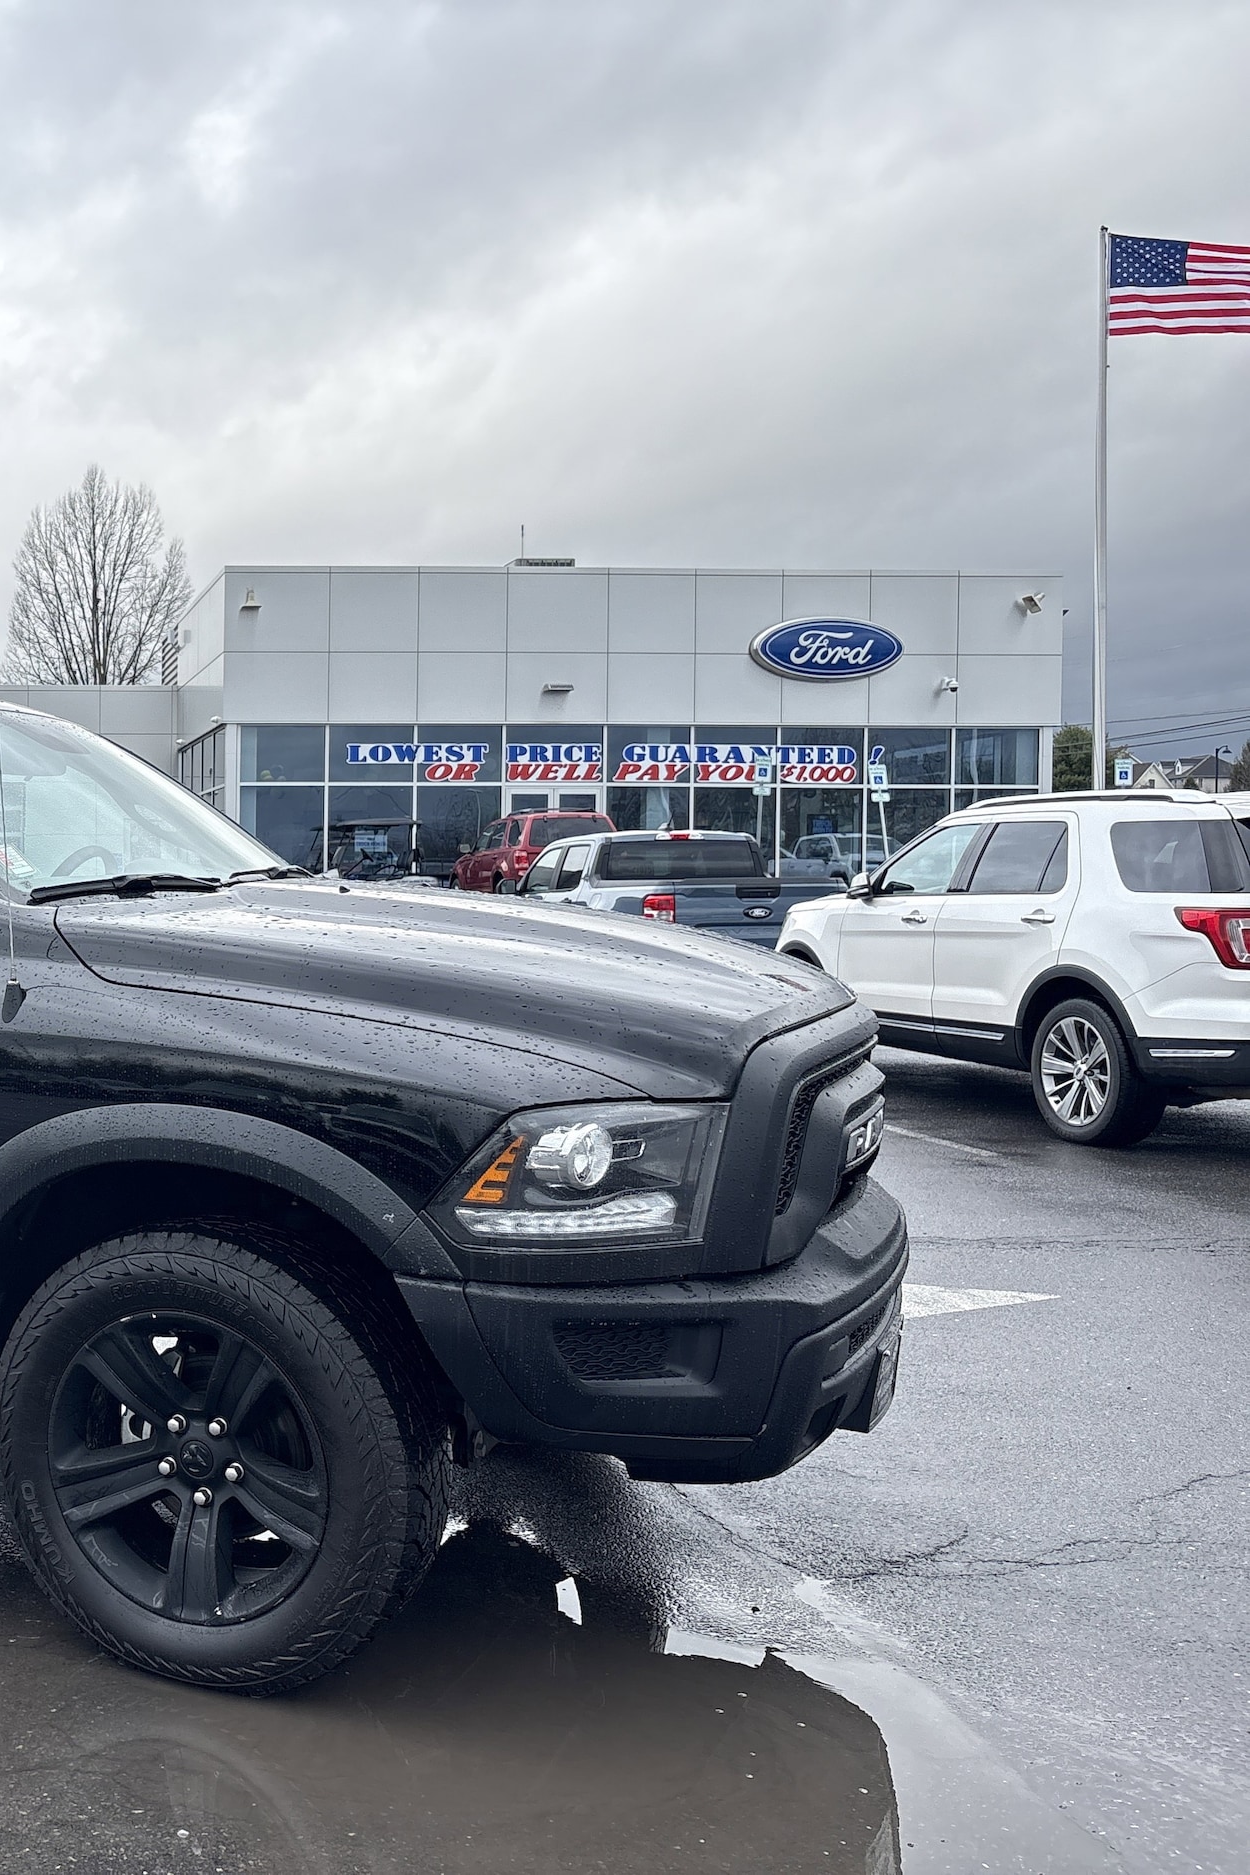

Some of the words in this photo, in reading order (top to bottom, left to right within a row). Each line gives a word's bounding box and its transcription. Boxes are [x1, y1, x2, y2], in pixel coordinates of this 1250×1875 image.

[790, 630, 874, 665] Ford
[347, 744, 488, 763] LOWEST
[507, 744, 601, 763] PRICE
[623, 744, 856, 765] GUARANTEED
[426, 763, 479, 782] OR
[614, 763, 688, 782] PAY
[781, 765, 856, 783] $1,000
[20, 1479, 77, 1585] KUMHO
